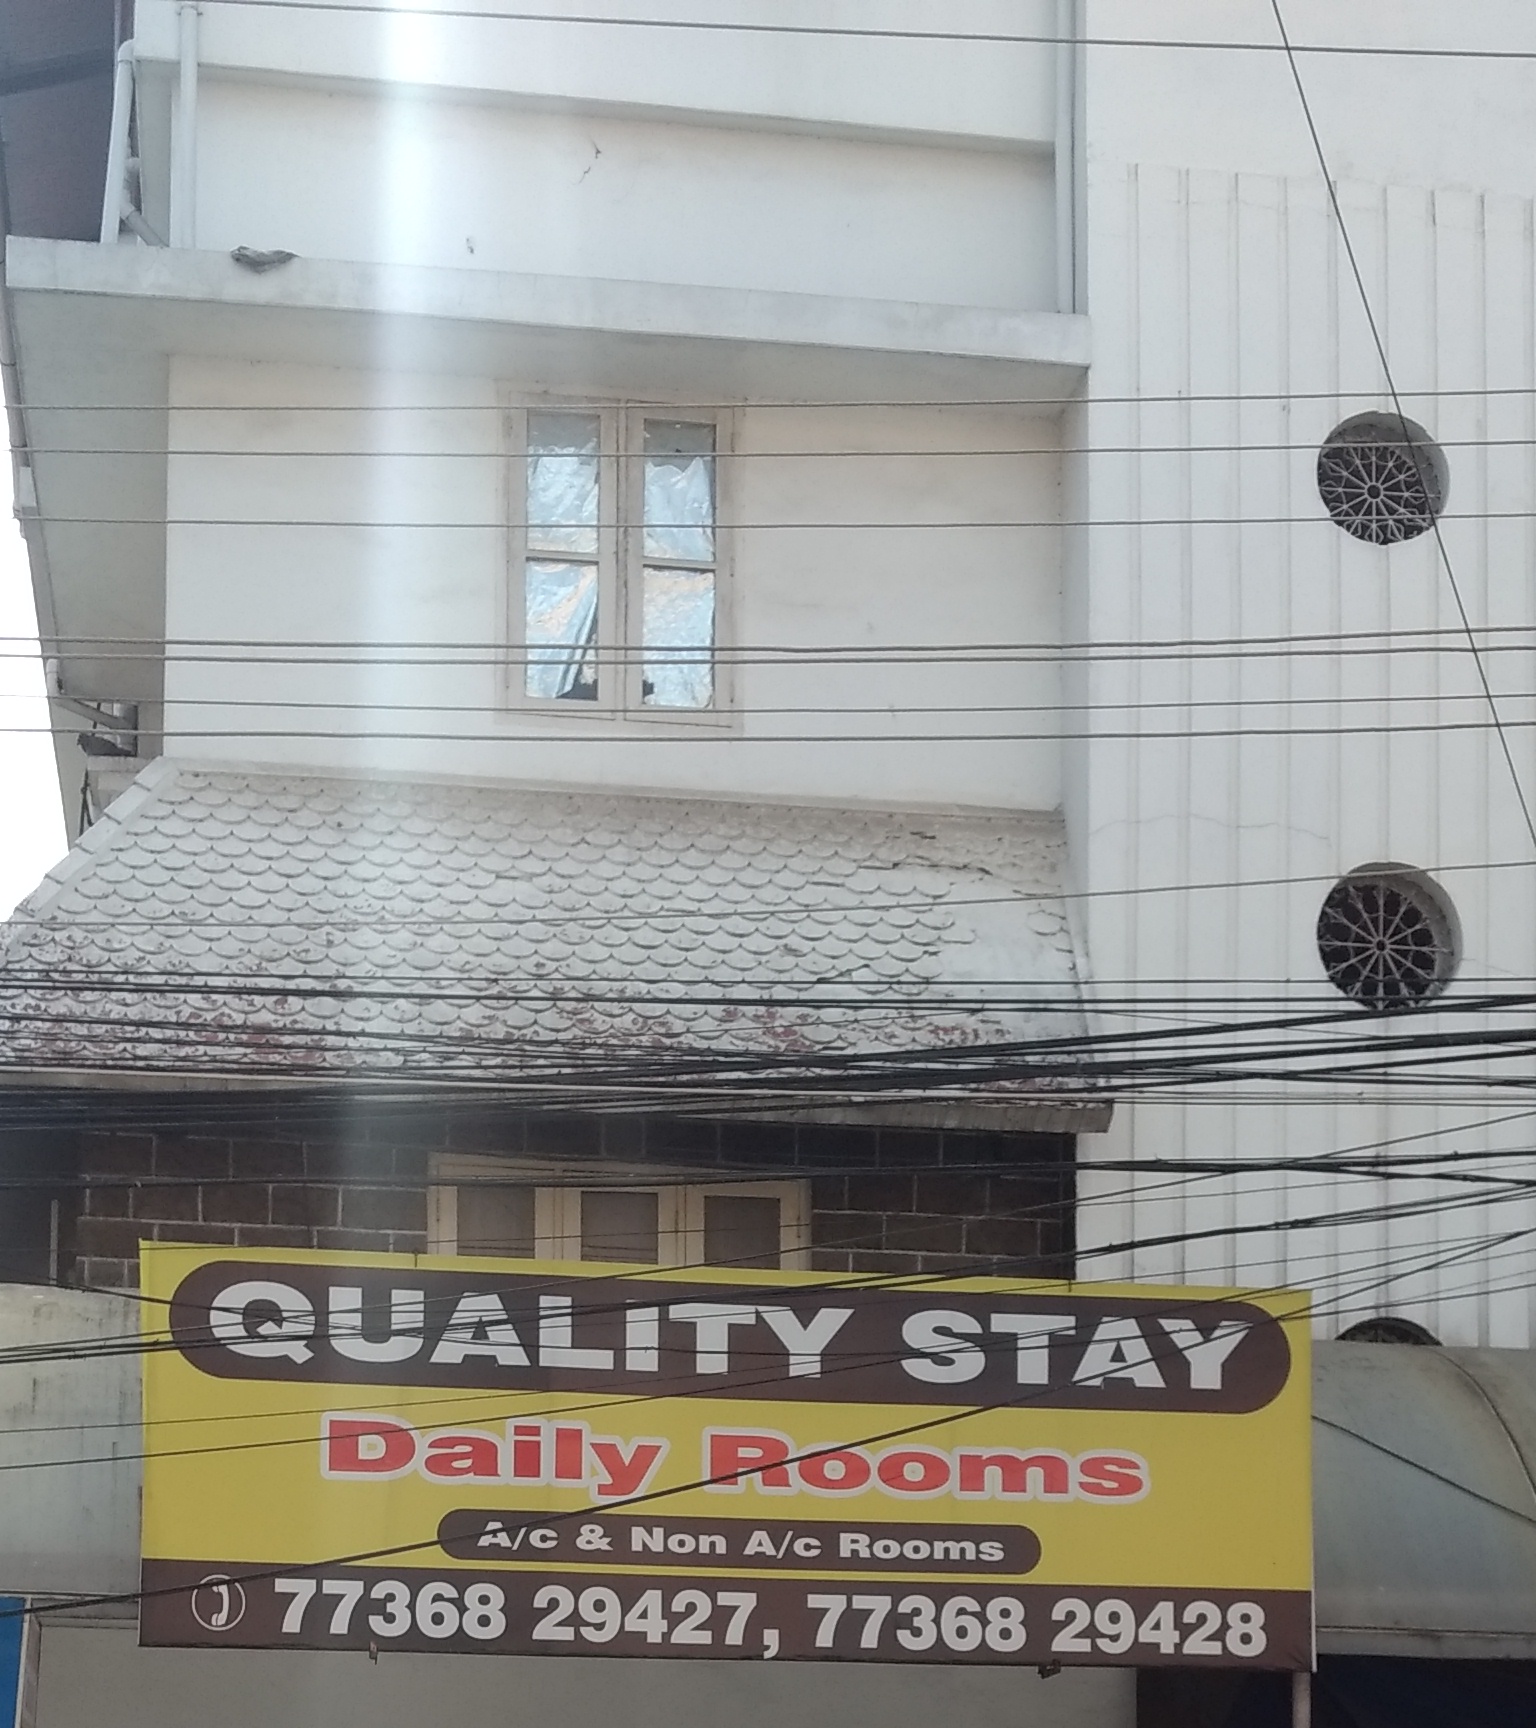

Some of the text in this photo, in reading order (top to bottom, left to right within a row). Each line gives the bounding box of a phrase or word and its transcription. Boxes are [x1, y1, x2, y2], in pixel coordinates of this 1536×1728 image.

[208, 1280, 1259, 1391] QUALITY STAY
[321, 1413, 1151, 1504] Daily Rooms
[478, 1520, 1005, 1563] A/c & Non A/c Rooms
[275, 1577, 1267, 1660] 77368 29427, 77368 29428
